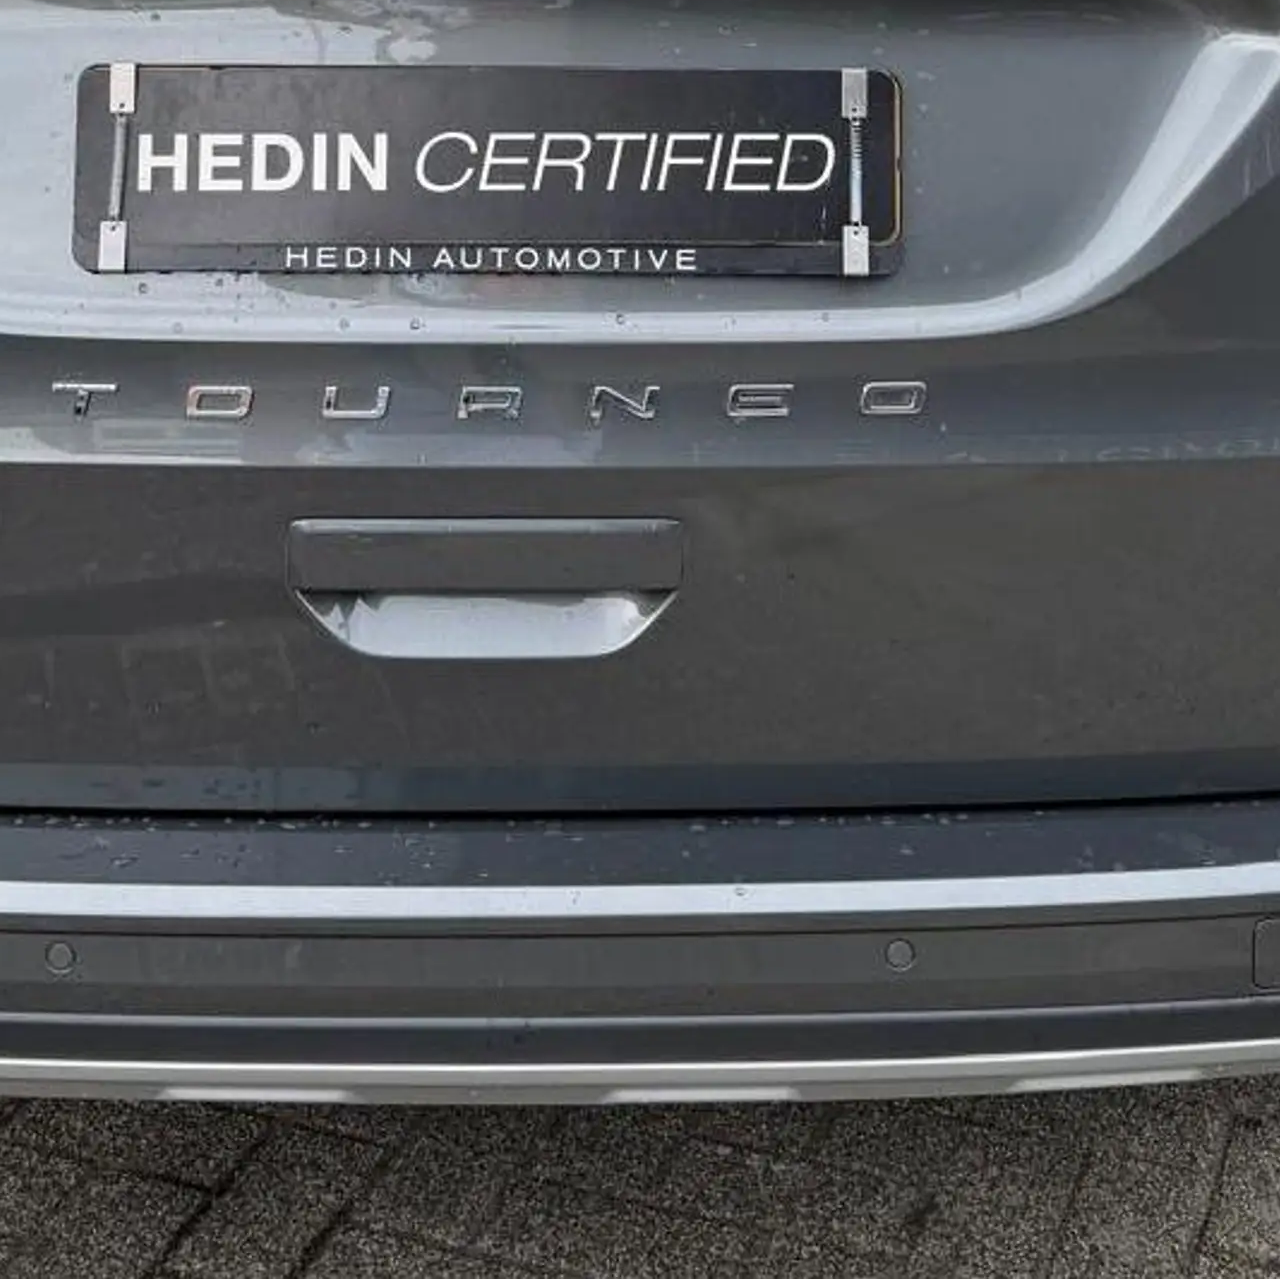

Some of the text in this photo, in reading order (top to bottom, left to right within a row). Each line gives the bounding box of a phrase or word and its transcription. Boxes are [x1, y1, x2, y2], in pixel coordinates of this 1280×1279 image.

[136, 131, 836, 193] HEDIN CERTIFIED
[285, 246, 698, 271] HEDIN AUTOMOTIVE
[50, 380, 928, 421] TOURNEO
